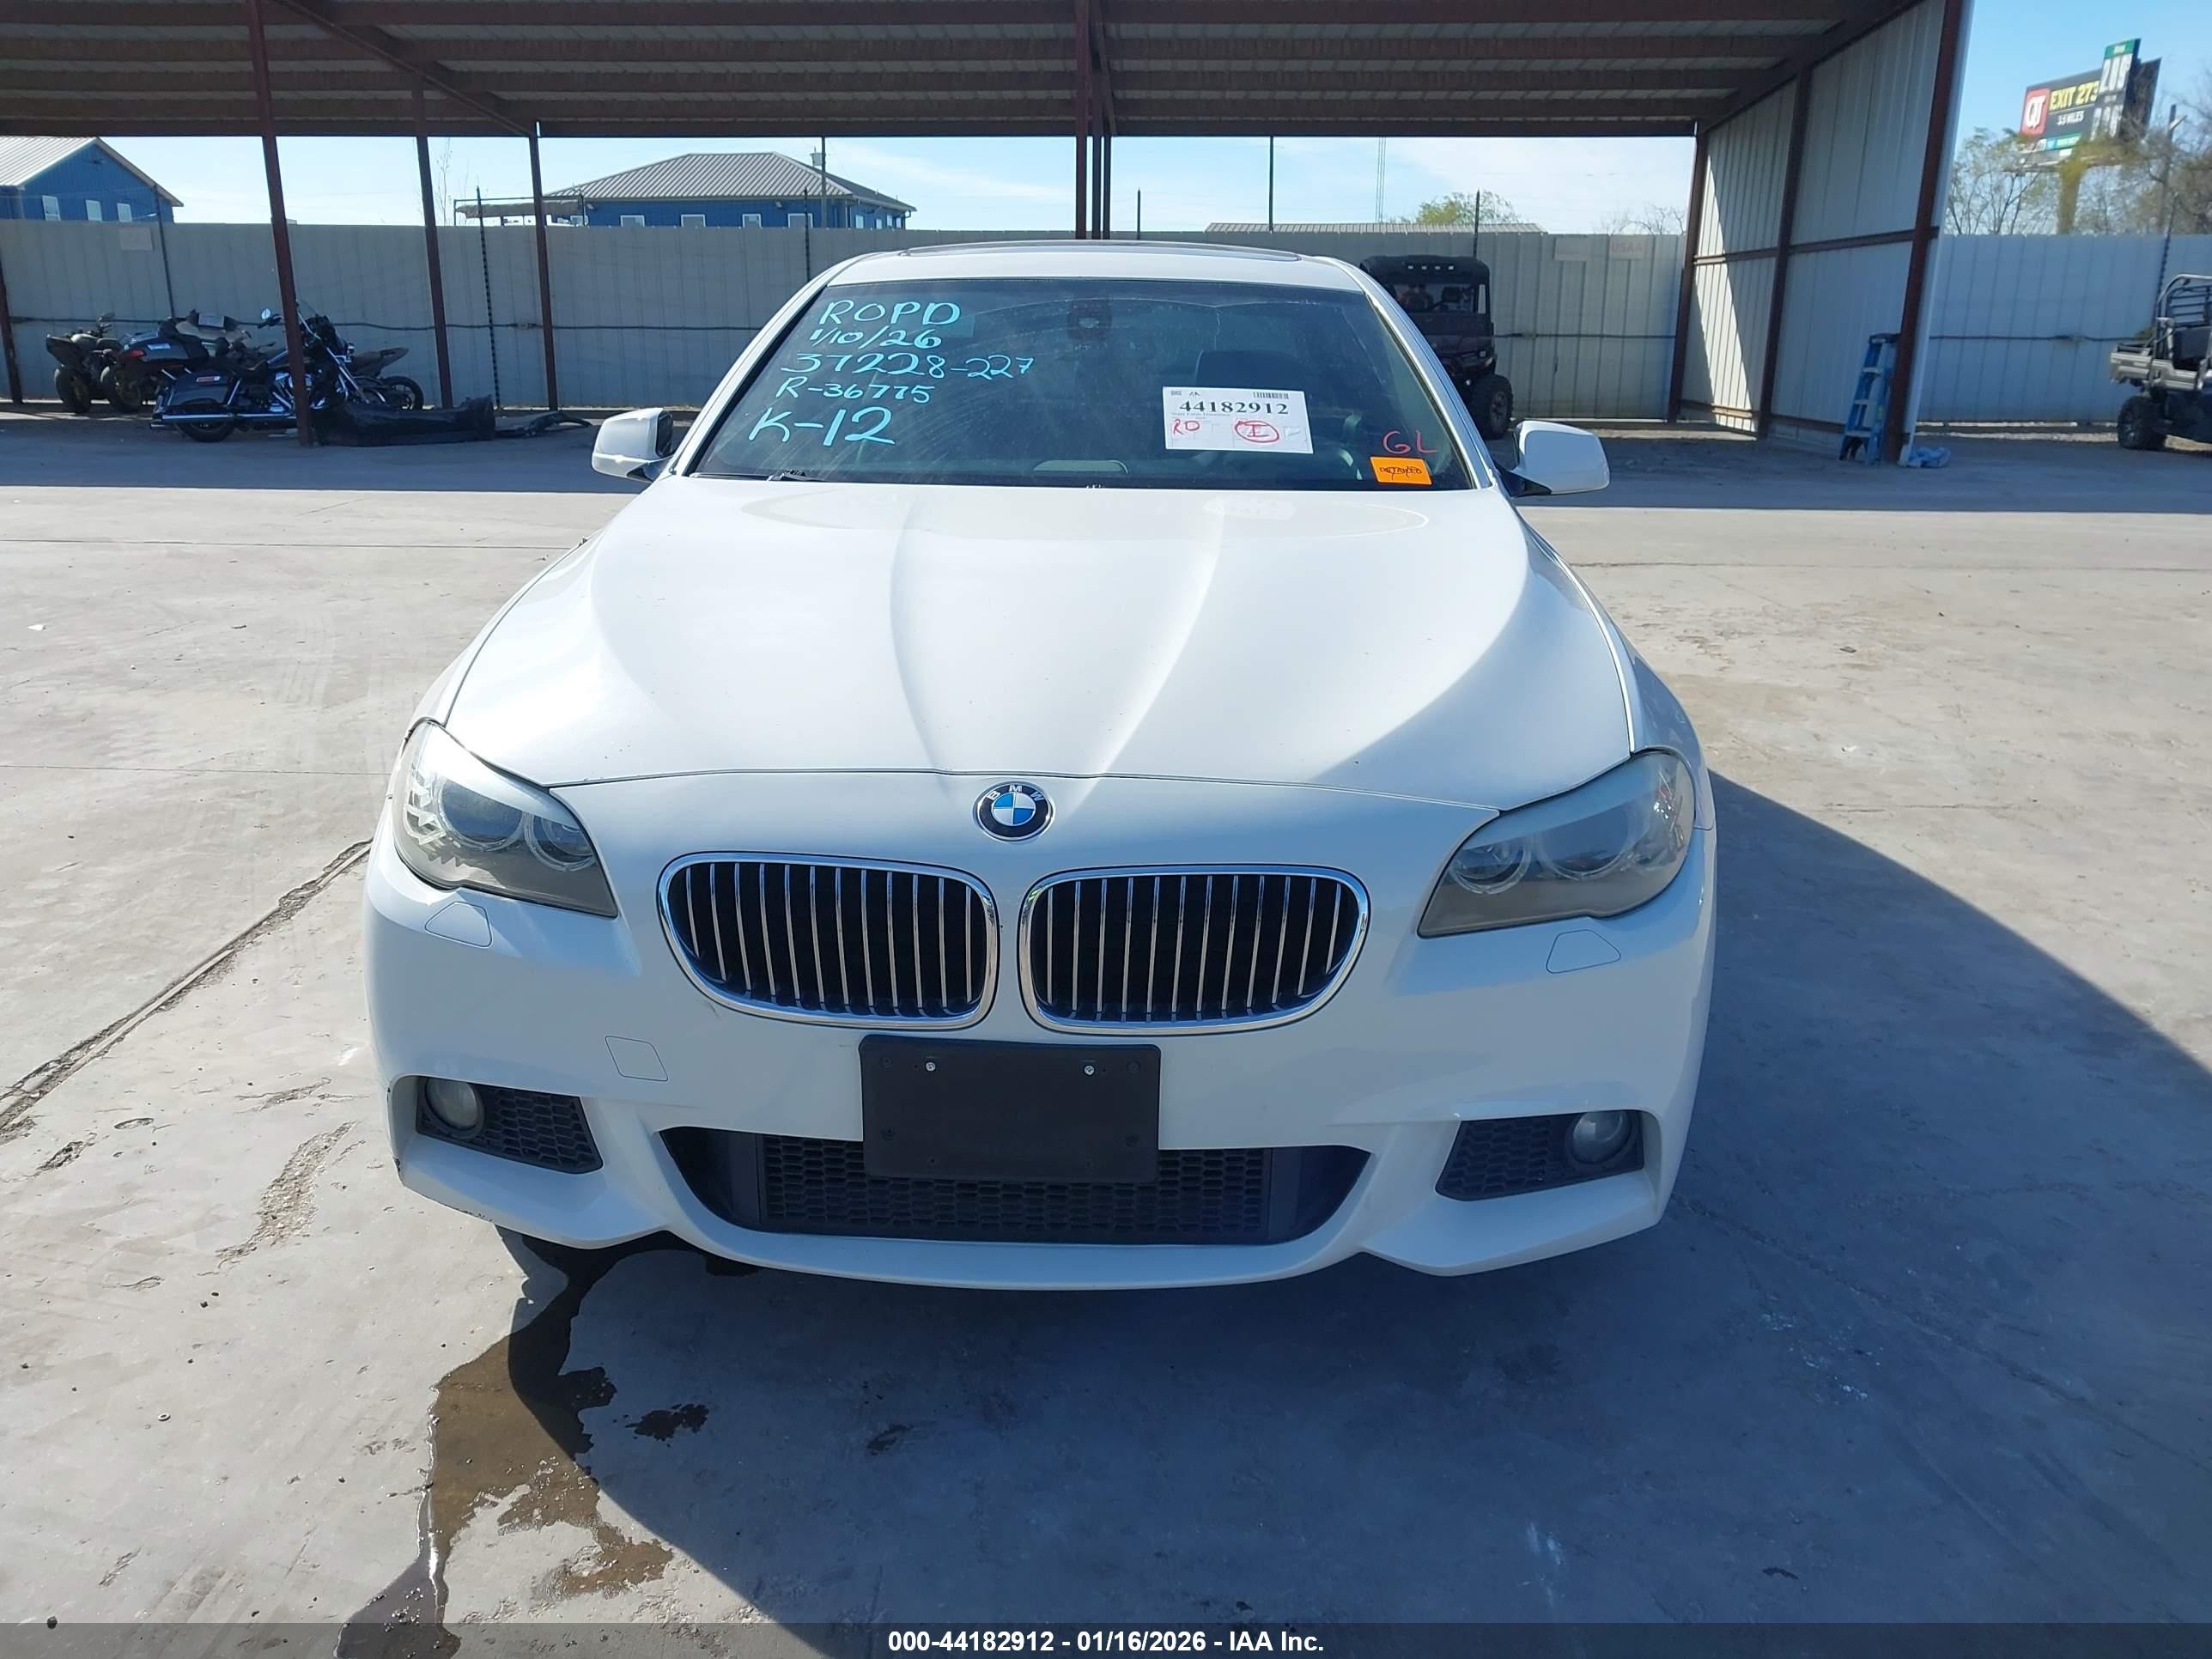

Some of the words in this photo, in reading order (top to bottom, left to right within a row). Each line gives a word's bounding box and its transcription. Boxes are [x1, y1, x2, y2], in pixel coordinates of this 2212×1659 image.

[2049, 86, 2076, 111] EXIT
[818, 300, 960, 325] ROPD
[809, 325, 942, 349] 1/10/26
[1179, 400, 1289, 415] 44182912
[748, 406, 895, 447] K-12
[1382, 429, 1440, 454] GL
[986, 785, 1045, 801] BMW
